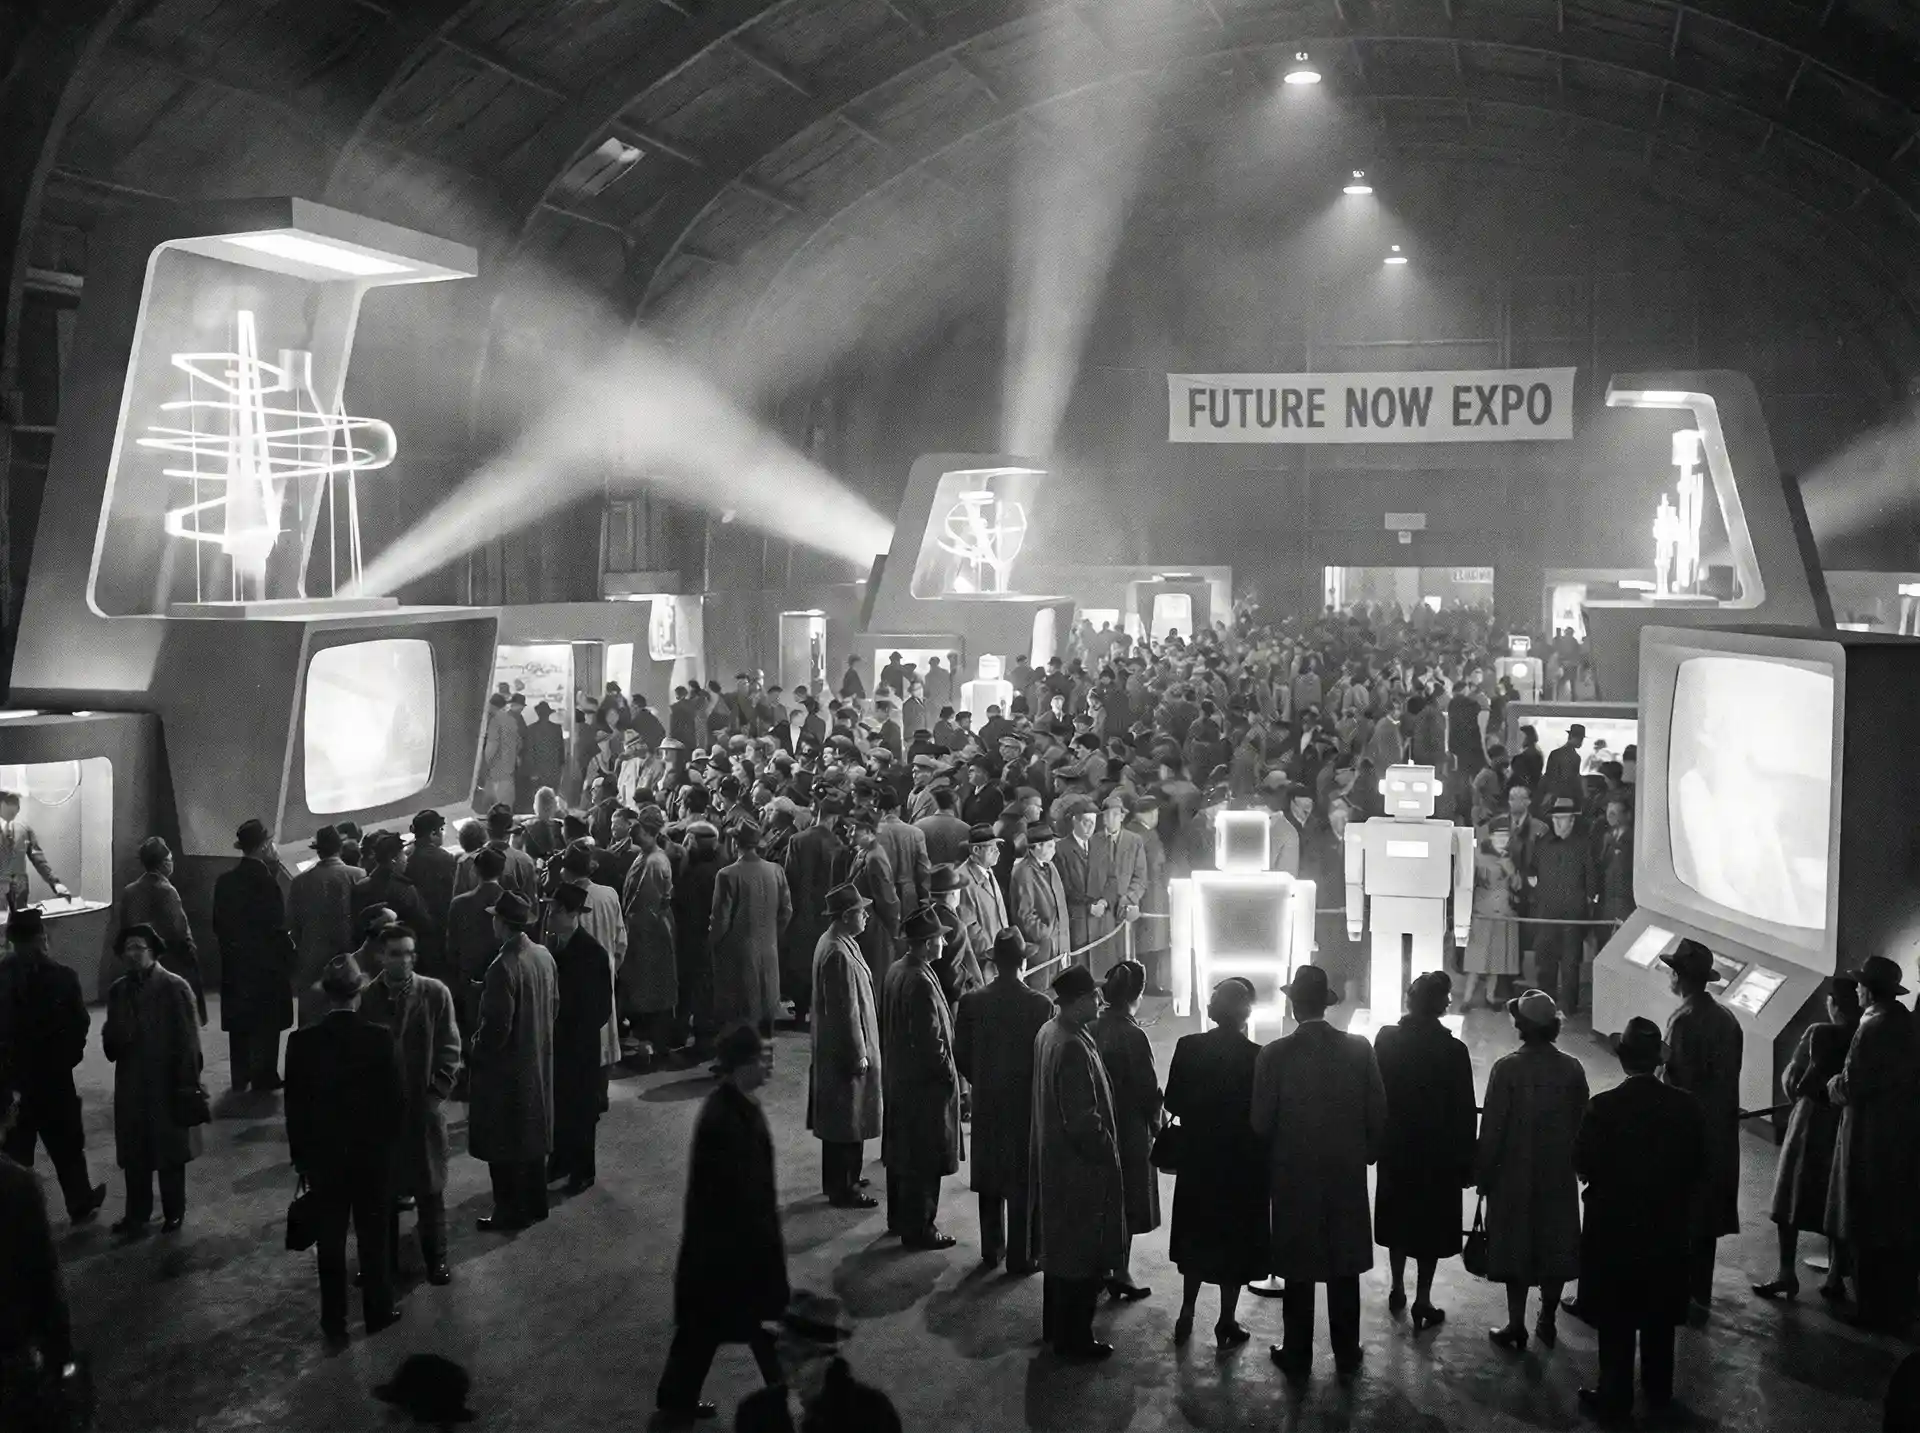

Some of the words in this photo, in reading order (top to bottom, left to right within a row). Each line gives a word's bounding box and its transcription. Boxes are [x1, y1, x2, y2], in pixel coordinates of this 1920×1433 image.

[1188, 387, 1326, 428] FUTURE
[1345, 386, 1433, 428] NOW
[1452, 382, 1553, 427] EXPO
